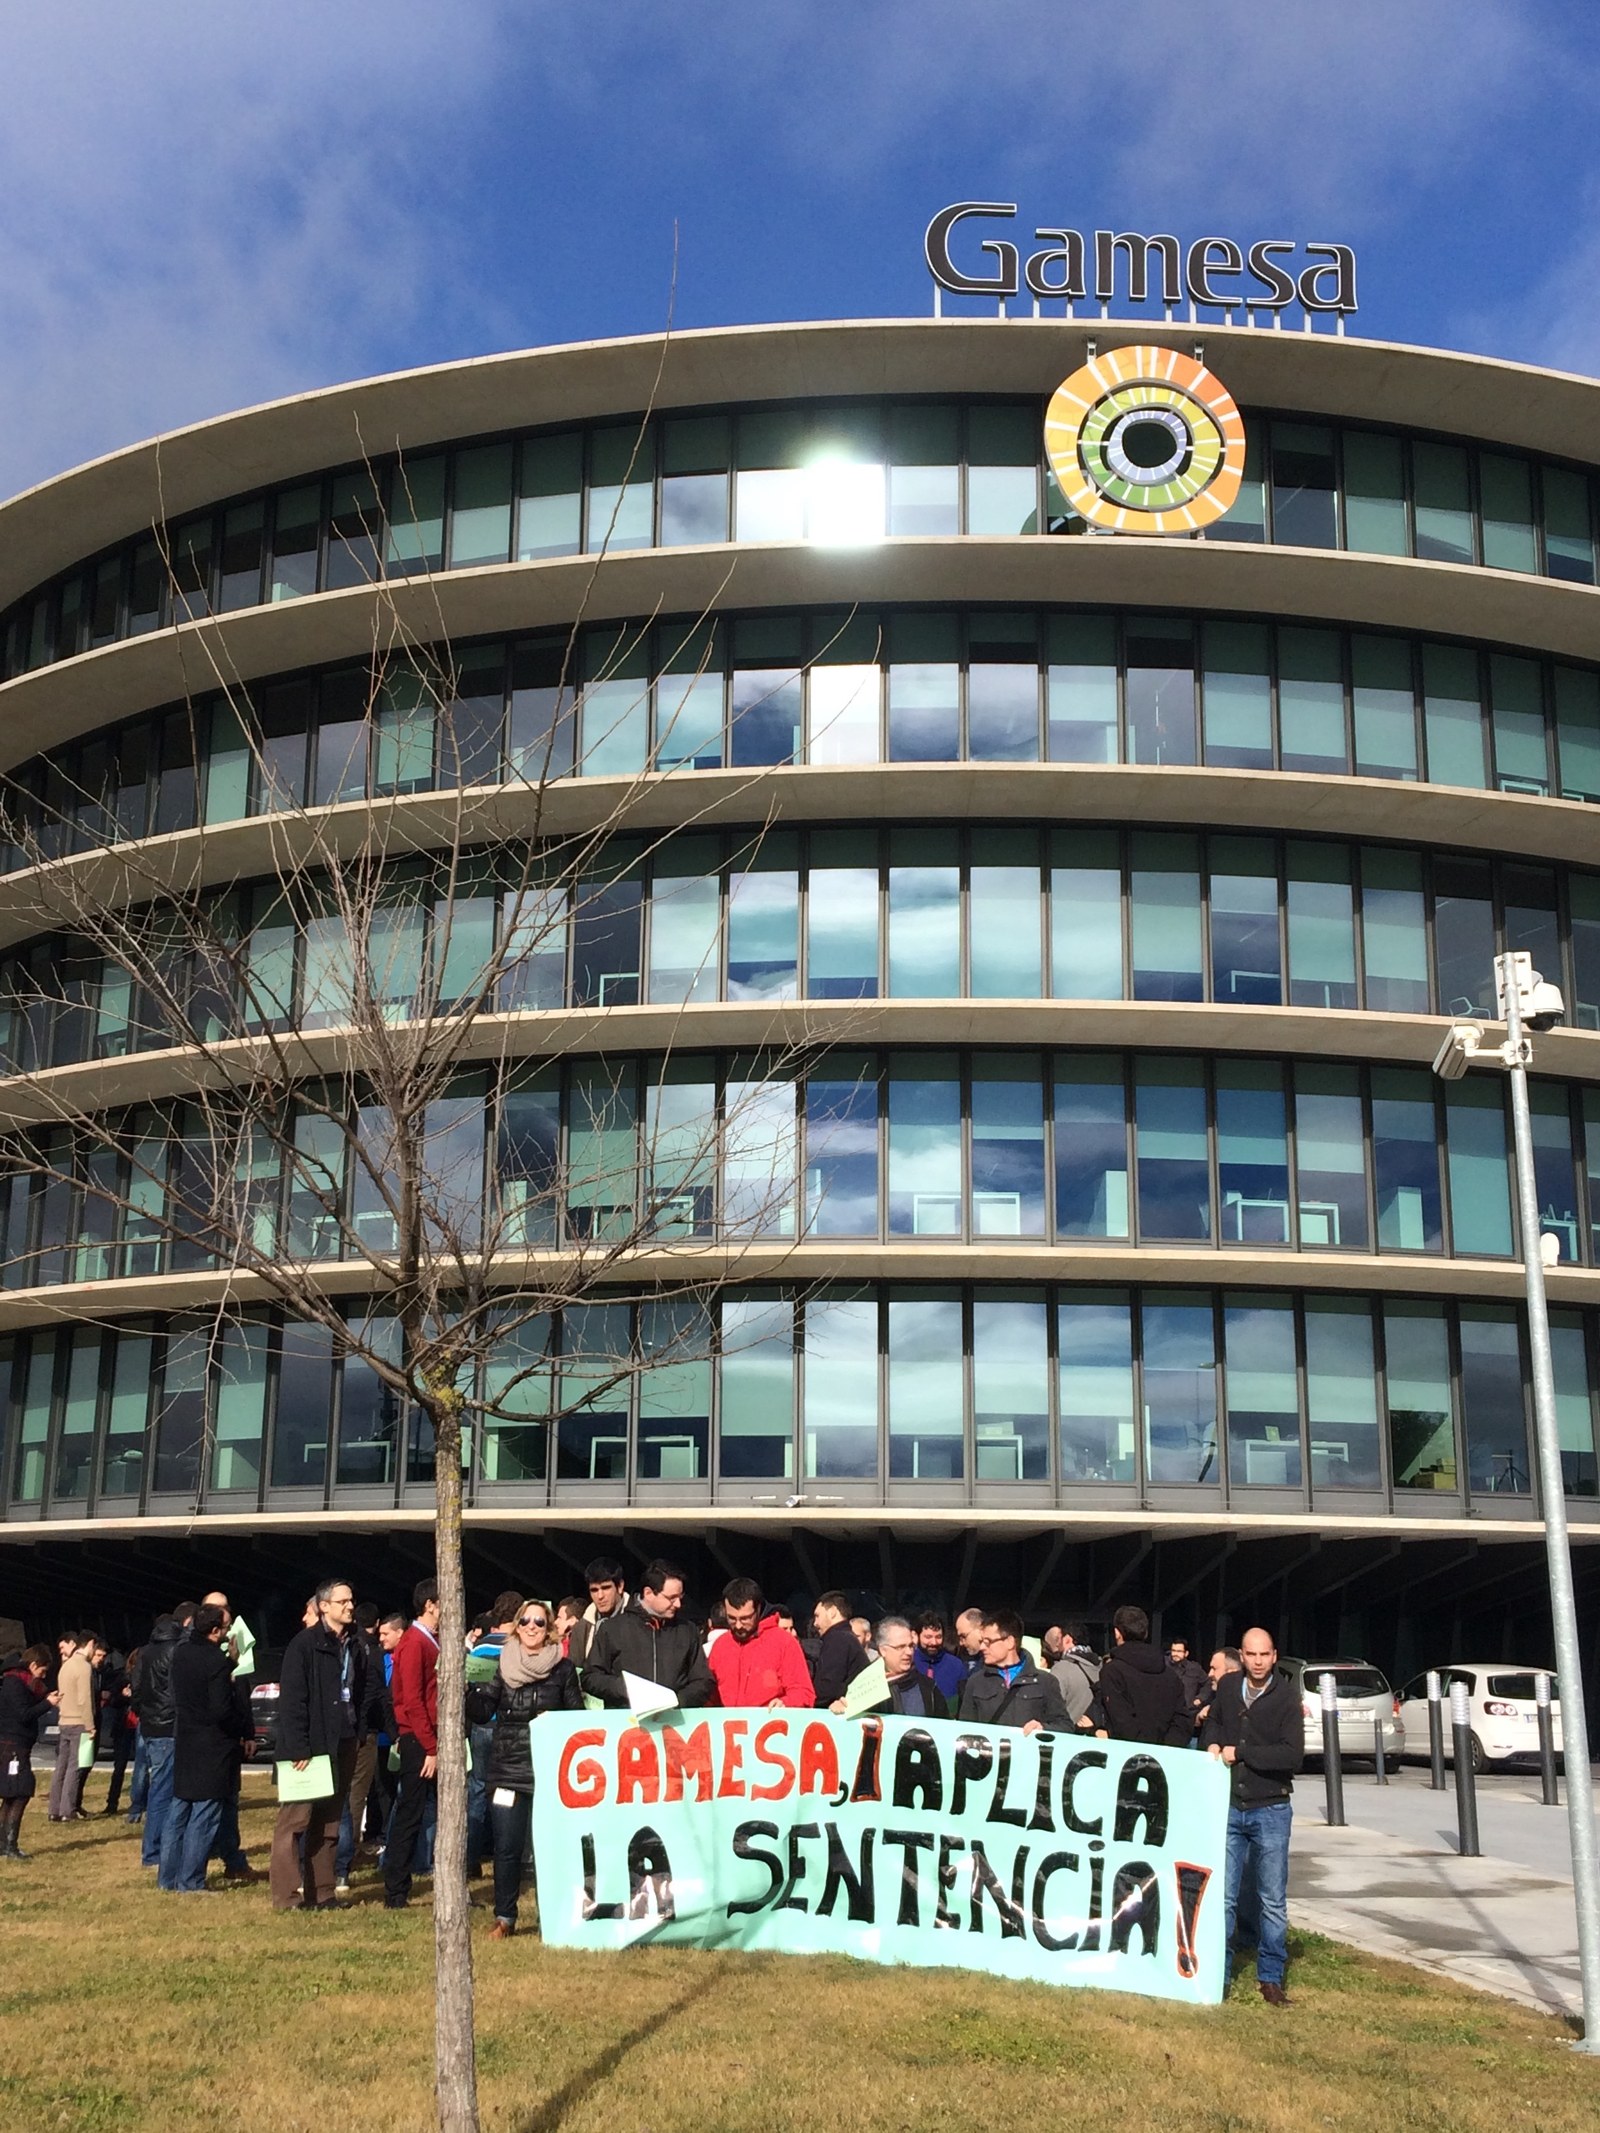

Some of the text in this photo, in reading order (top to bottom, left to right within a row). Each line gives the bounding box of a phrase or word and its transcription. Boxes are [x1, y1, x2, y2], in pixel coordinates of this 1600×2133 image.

[924, 202, 1358, 313] Gamesa
[558, 1719, 849, 1808] GAMESA,
[581, 1825, 676, 1921] LA
